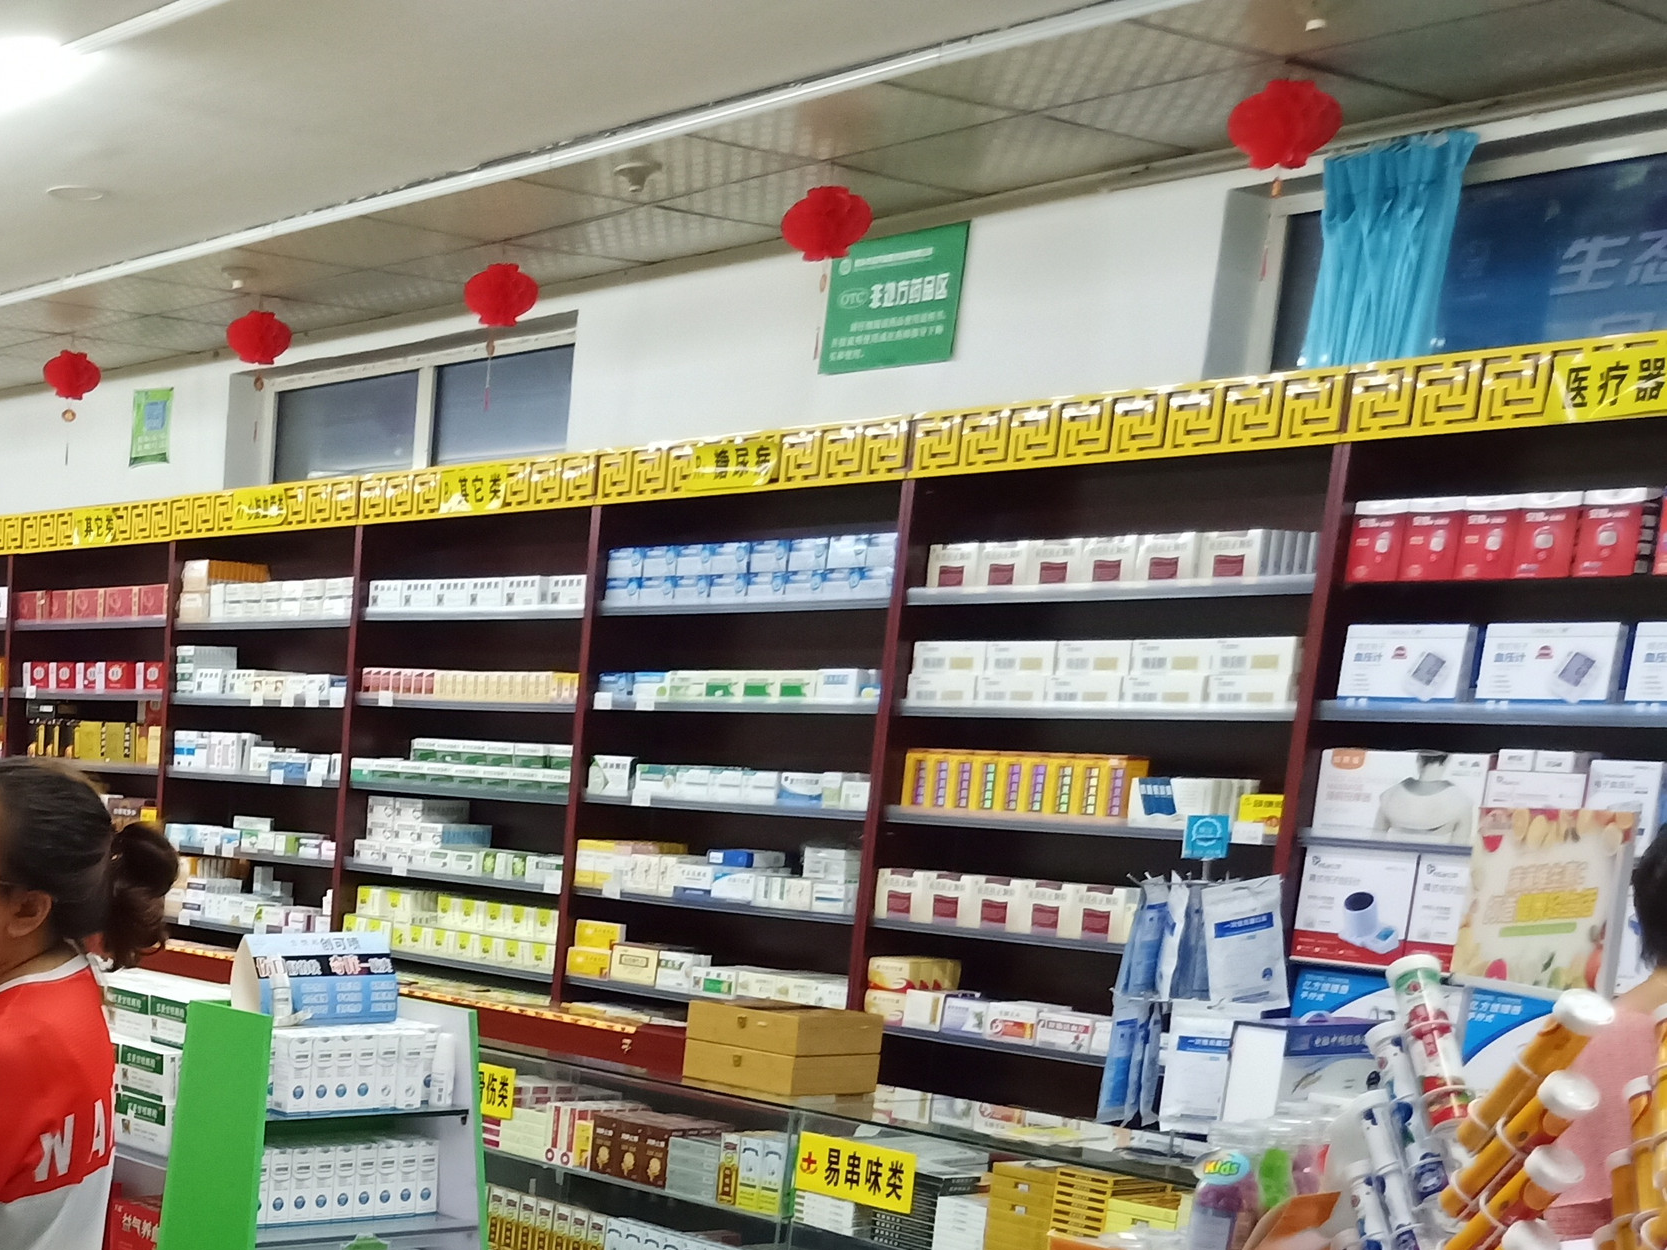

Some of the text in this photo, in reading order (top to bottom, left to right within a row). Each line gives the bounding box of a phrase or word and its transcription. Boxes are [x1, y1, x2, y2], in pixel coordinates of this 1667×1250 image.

[824, 1147, 905, 1201] 易串味类
[1203, 1160, 1241, 1177] Kids
